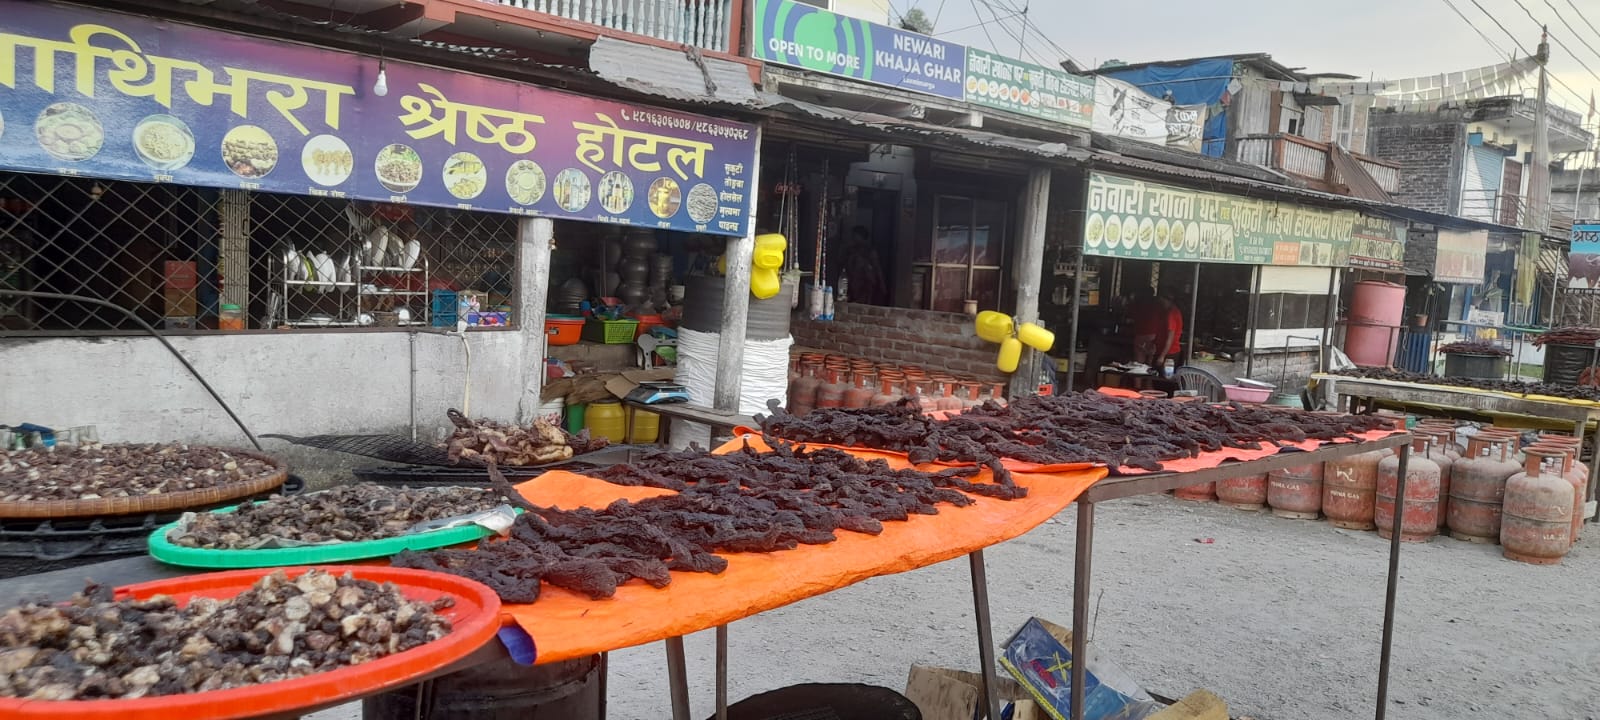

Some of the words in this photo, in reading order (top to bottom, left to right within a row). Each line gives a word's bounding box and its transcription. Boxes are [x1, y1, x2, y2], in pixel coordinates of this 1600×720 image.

[769, 38, 804, 57] OPEN
[806, 46, 824, 61] TO
[826, 52, 861, 70] MORE
[893, 34, 945, 61] NEWARI
[968, 50, 991, 76] नेवारी
[875, 50, 921, 75] KHAJA
[924, 62, 961, 84] GHAR
[0, 24, 356, 136] ाथिभरा
[398, 83, 546, 154] श्रेष्ठ
[572, 112, 714, 181] होटल
[1089, 175, 1147, 215] नेवारी
[1147, 187, 1197, 220] खाना
[1197, 194, 1228, 222] घर
[1231, 199, 1264, 238] सुकुटी
